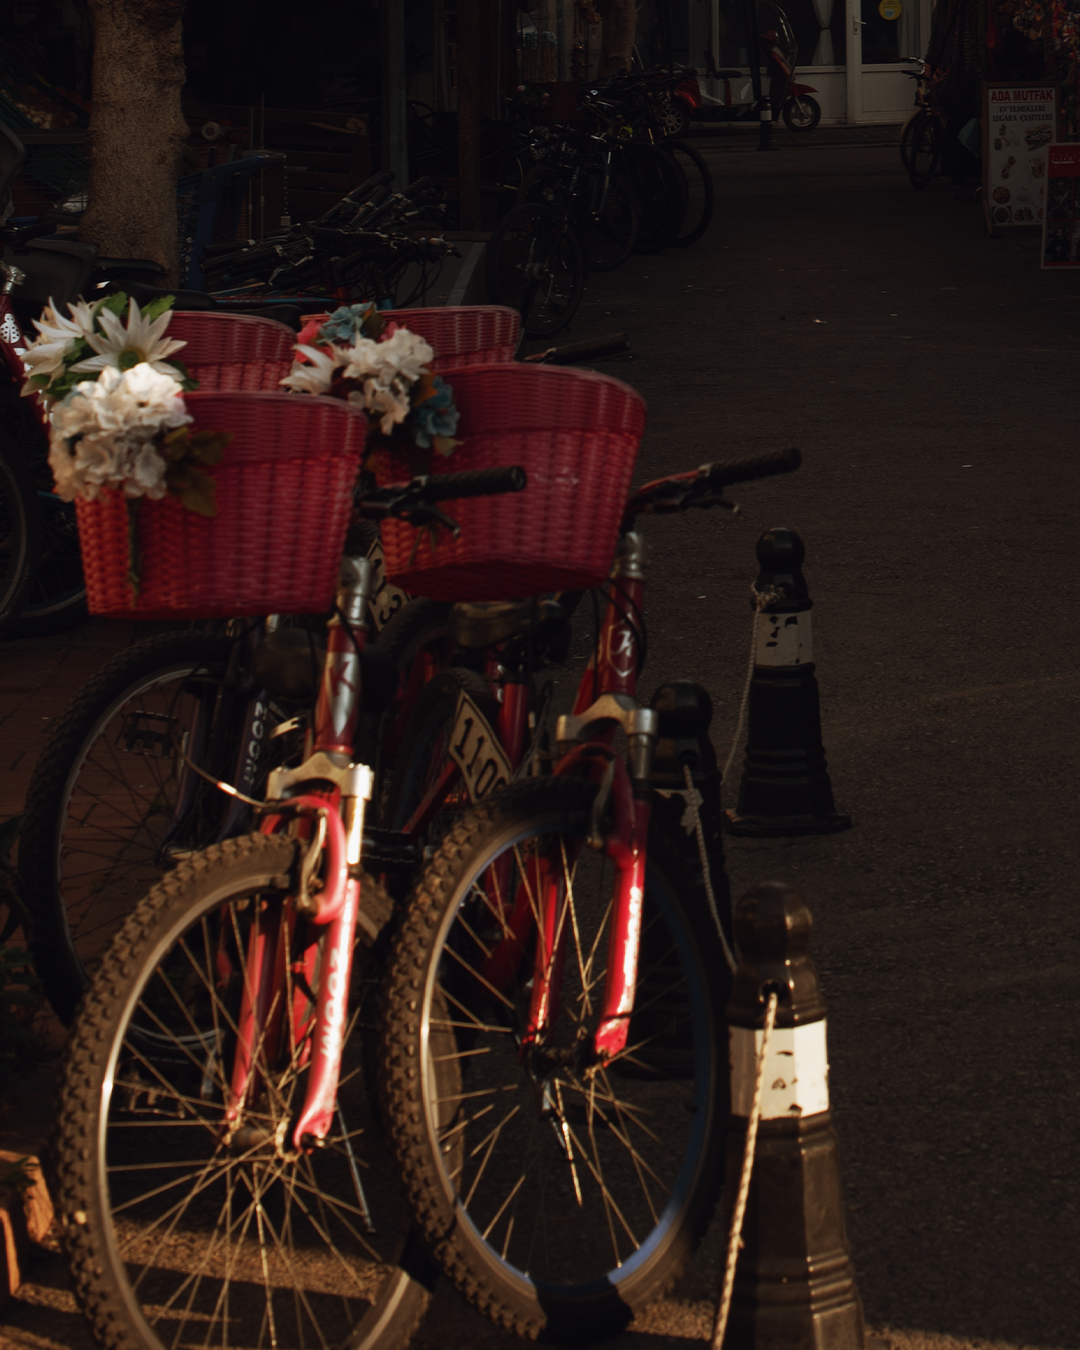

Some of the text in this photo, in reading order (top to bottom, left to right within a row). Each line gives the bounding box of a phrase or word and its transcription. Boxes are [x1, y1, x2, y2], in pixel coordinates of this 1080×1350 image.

[991, 90, 1053, 102] ADA MUTFAK
[454, 717, 506, 799] 110
